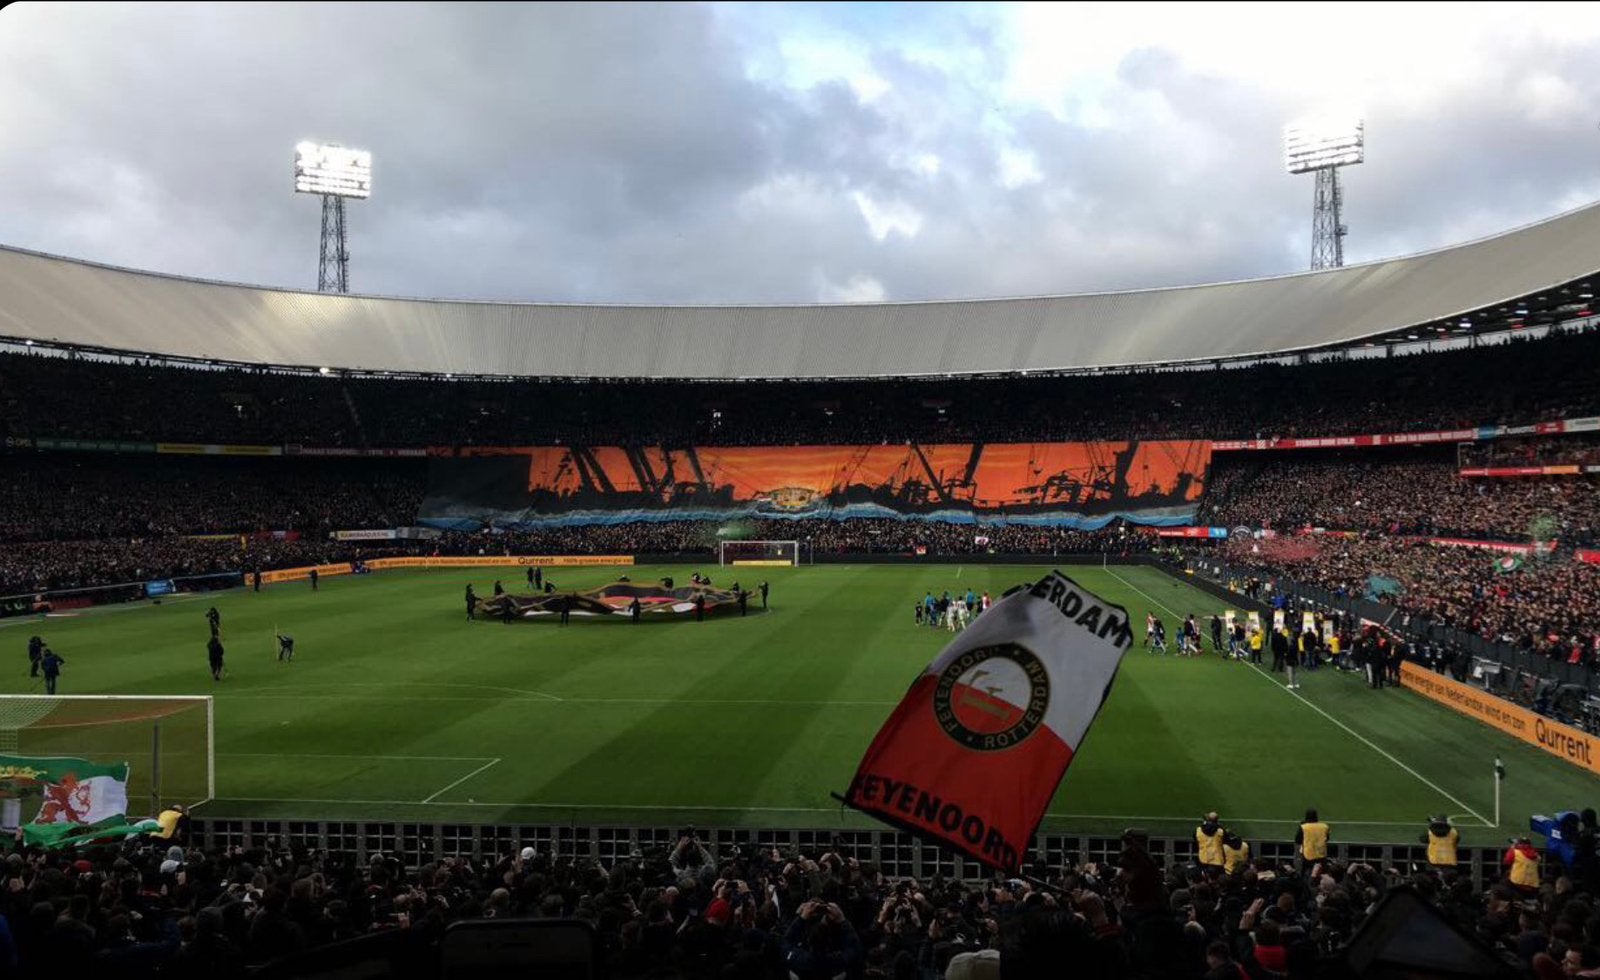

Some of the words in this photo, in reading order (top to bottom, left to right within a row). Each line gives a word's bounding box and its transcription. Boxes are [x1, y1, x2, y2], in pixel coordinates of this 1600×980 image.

[518, 556, 555, 565] Qurrent
[983, 660, 1048, 749] ROTTERDAM
[1535, 717, 1592, 766] Qurrent
